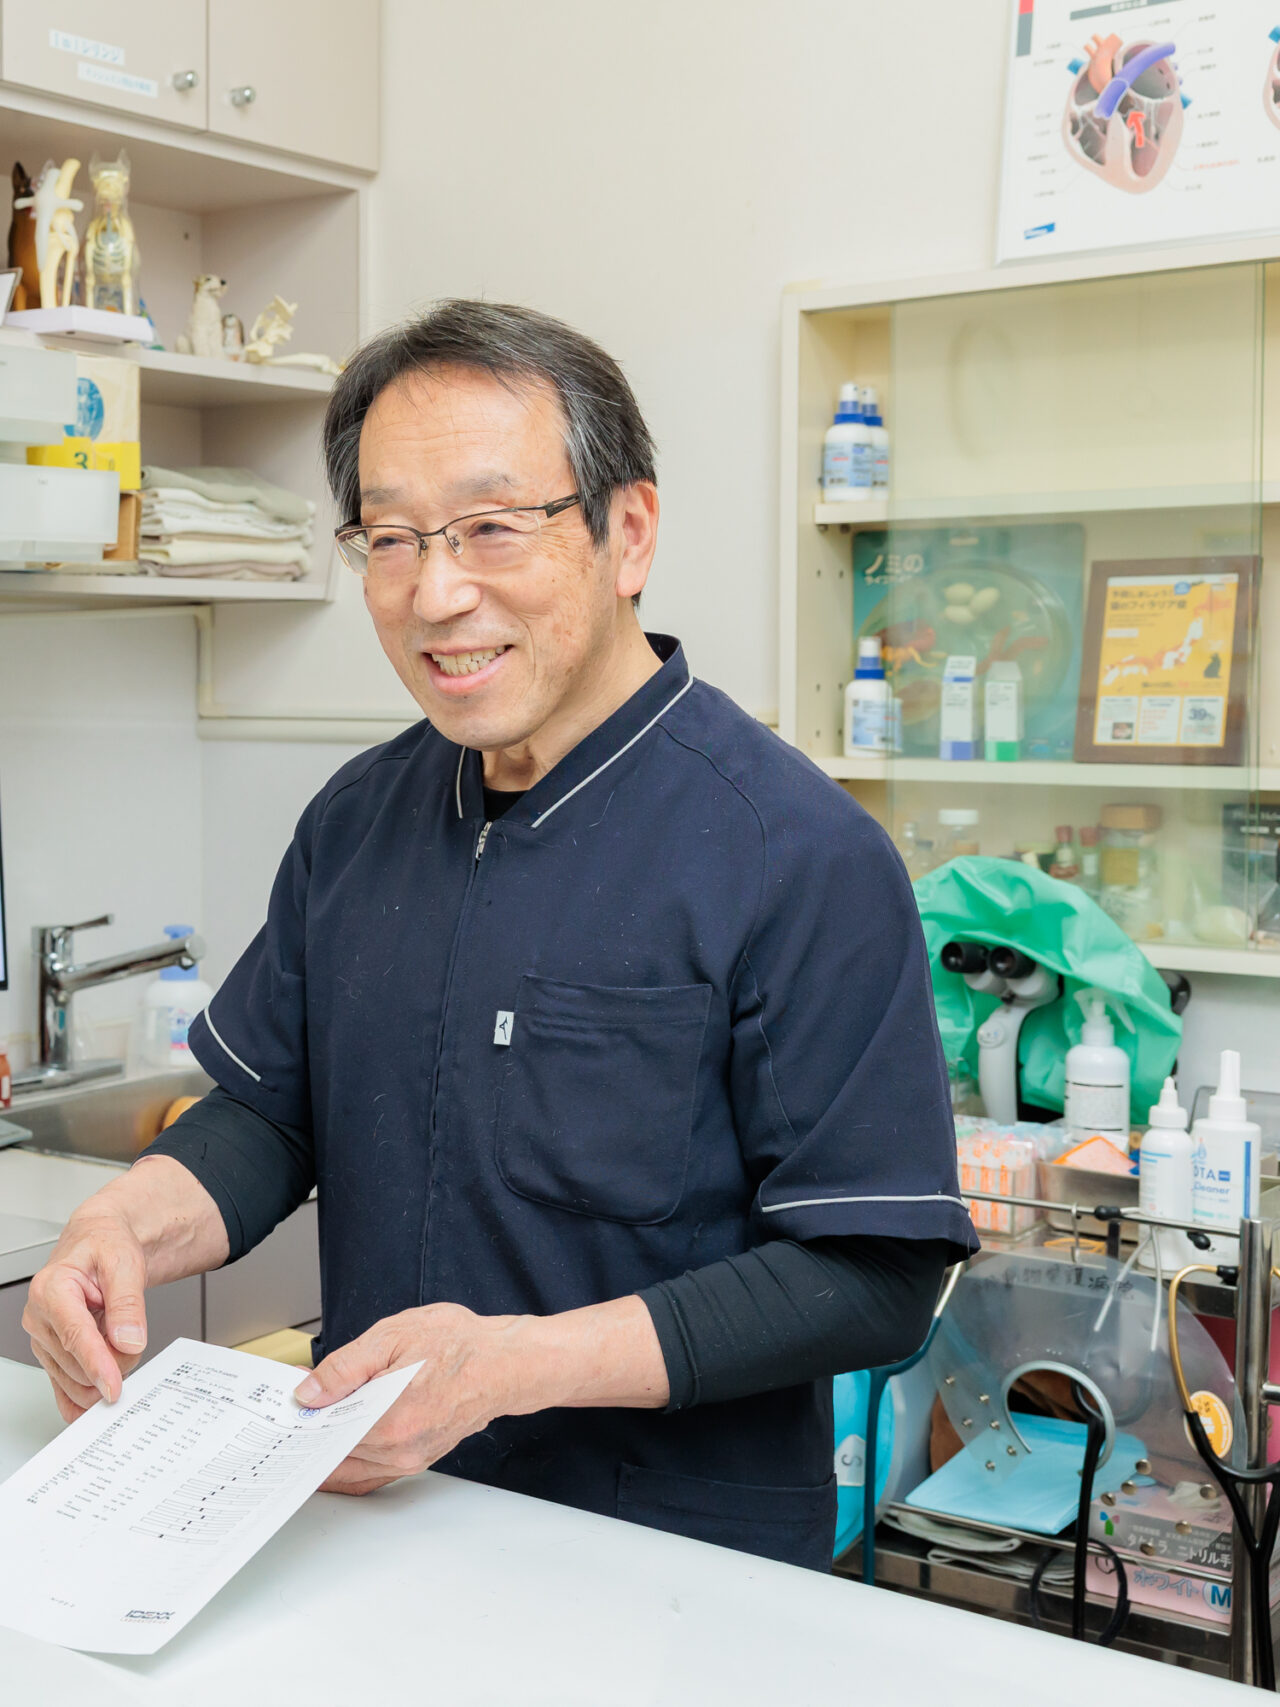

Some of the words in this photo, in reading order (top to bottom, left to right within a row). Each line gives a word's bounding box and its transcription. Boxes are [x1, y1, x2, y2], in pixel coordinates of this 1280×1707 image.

[1134, 1567, 1199, 1598] ホワイト
[1211, 1585, 1232, 1608] M
